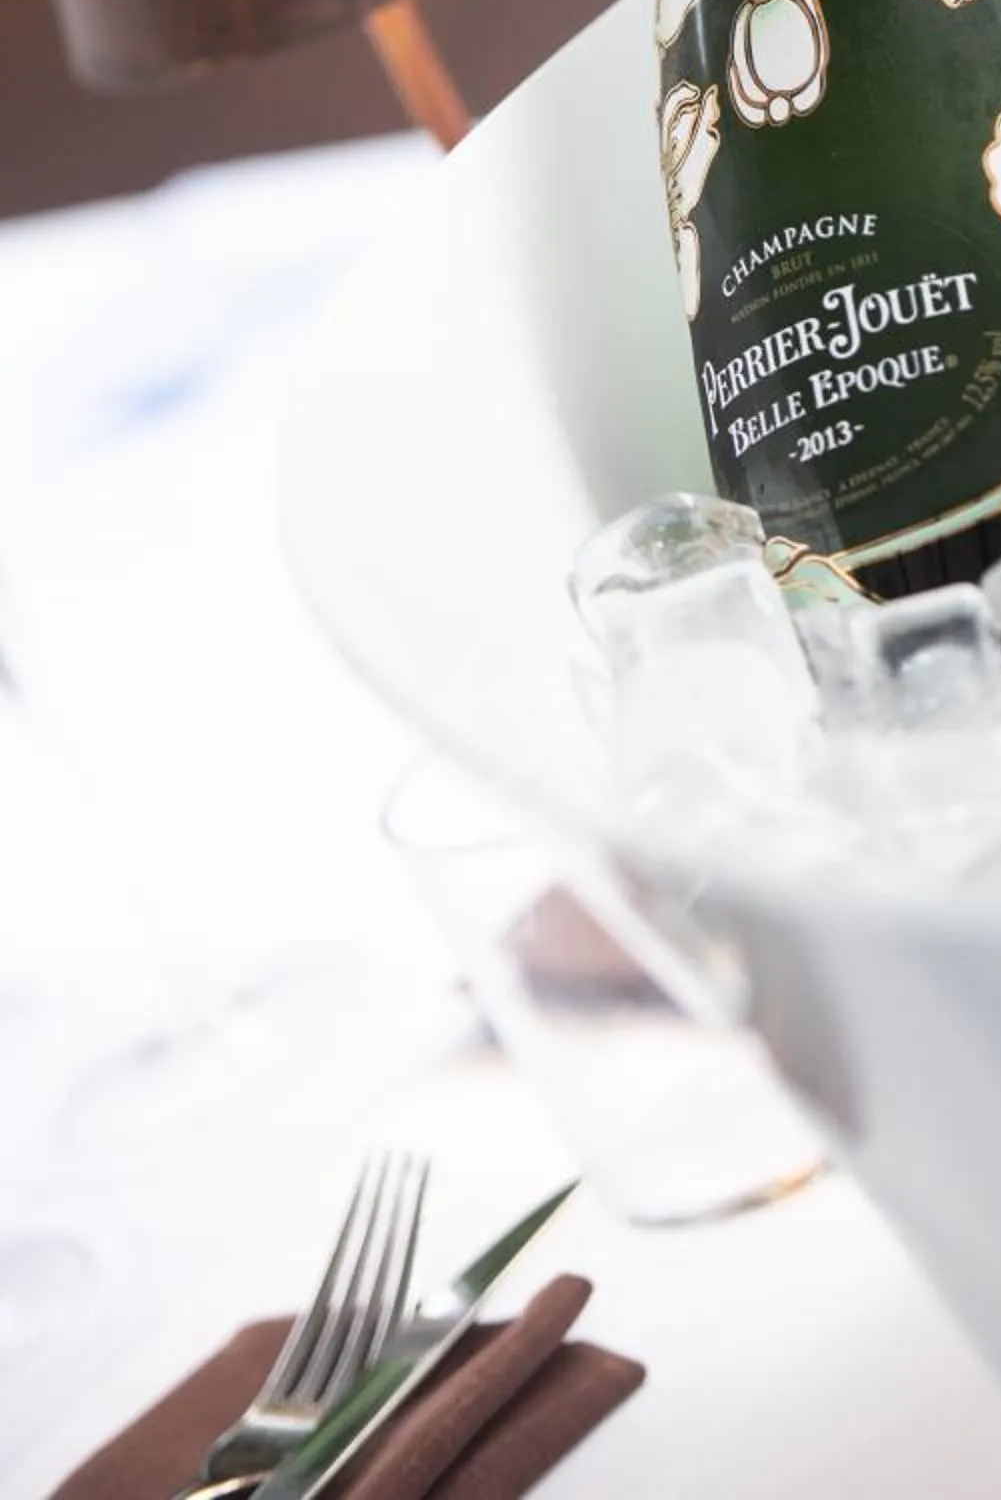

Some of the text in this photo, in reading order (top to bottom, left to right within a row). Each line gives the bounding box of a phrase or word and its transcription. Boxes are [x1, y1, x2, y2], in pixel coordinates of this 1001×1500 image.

[721, 213, 879, 298] CHAMPAGNE
[771, 250, 815, 281] BRUT
[701, 272, 978, 441] PERRIER-JOUËT
[727, 345, 945, 458] BELLE EPOQUE
